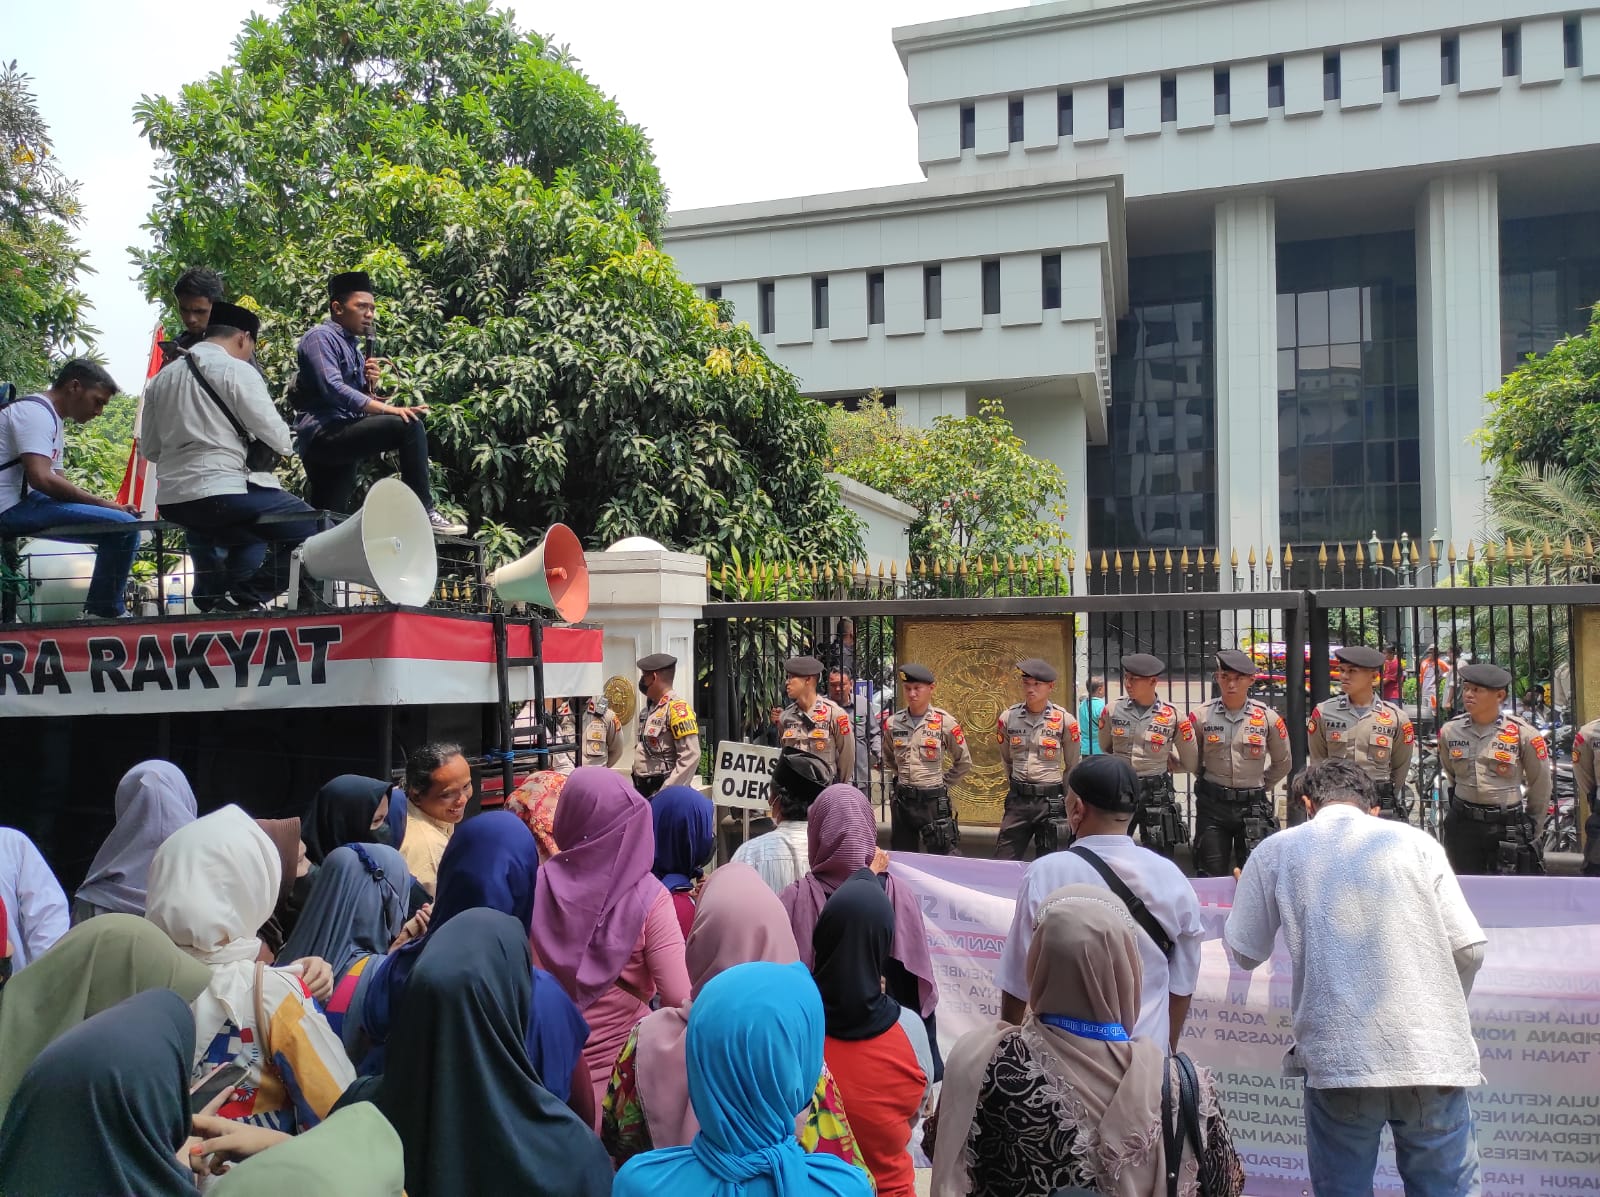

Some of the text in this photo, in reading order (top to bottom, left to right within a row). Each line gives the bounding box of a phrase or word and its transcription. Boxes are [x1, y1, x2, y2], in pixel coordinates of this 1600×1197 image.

[0, 625, 342, 695] RA RAKYAT
[1372, 725, 1394, 735] POLRI
[1492, 742, 1518, 753] POLRI
[721, 751, 778, 775] BATAS
